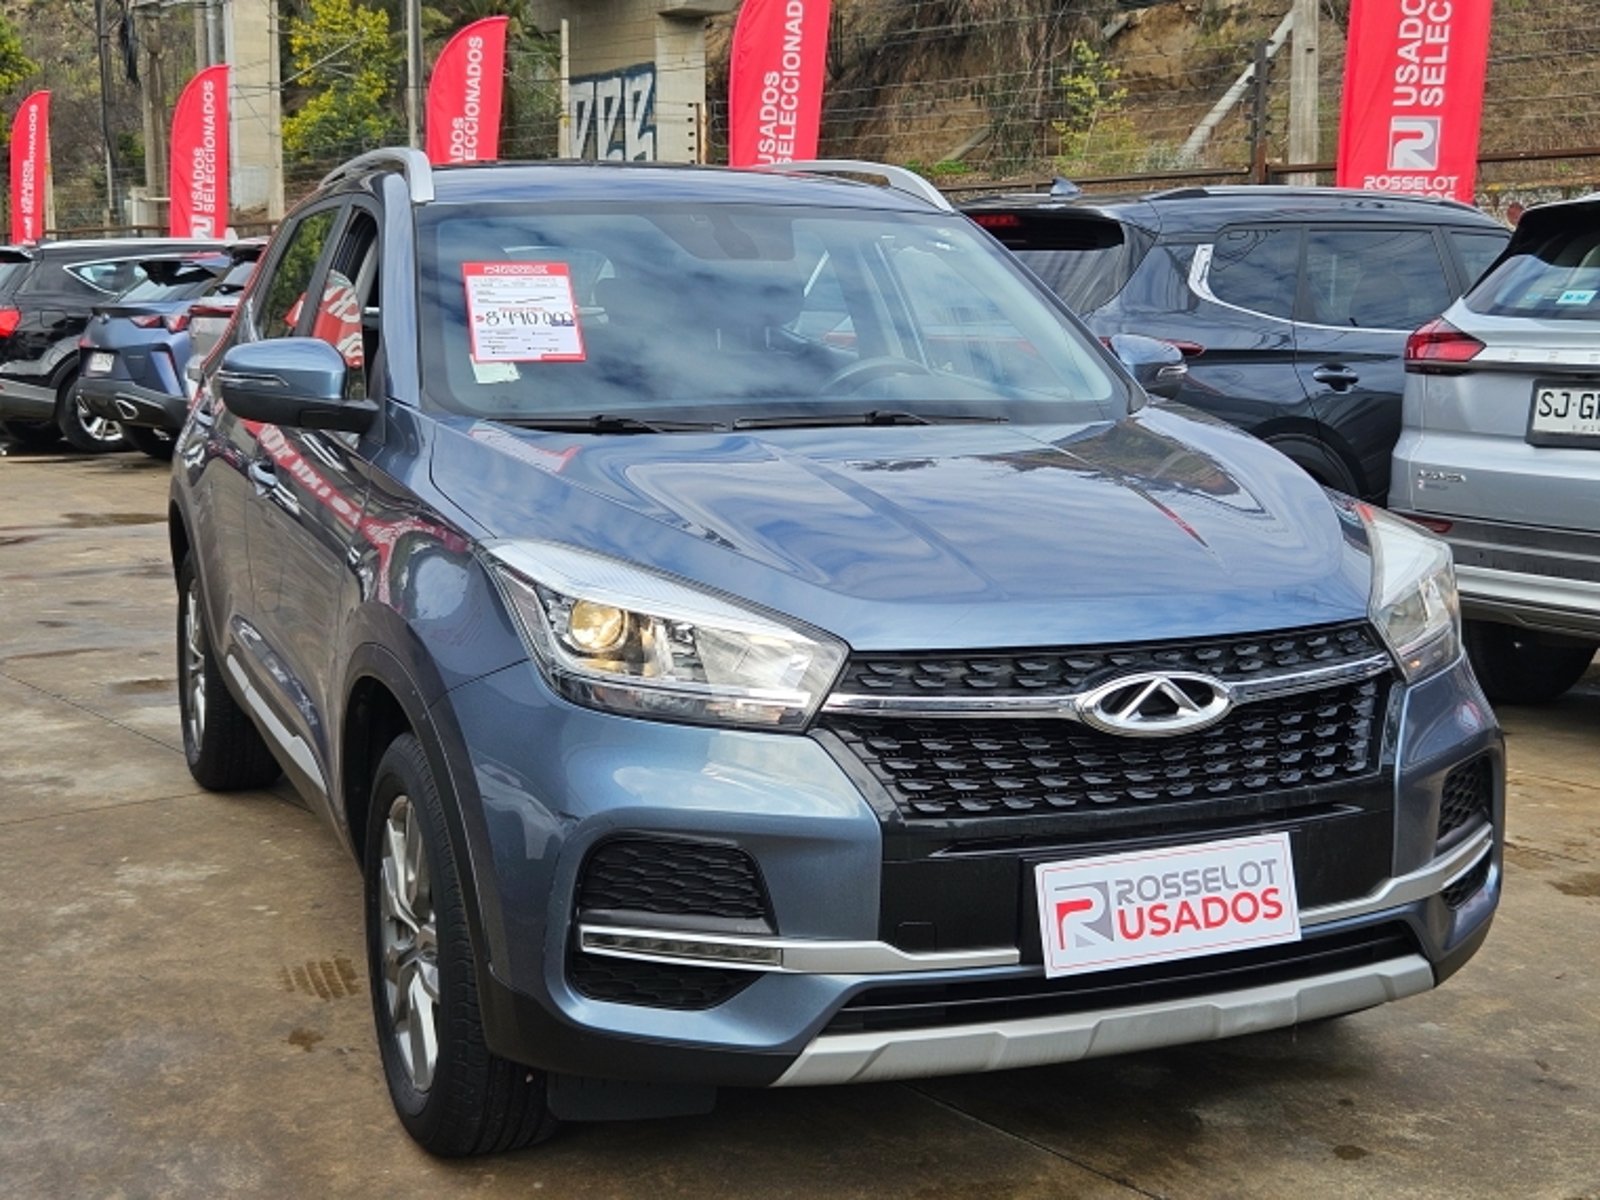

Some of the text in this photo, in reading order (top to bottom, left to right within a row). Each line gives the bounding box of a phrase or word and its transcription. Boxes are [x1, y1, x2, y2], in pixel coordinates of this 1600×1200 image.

[202, 81, 216, 213] SELECCIONADOS
[192, 147, 205, 212] USADOS
[1364, 175, 1459, 190] ROSSELOT
[1115, 859, 1278, 905] ROSSELOT
[1117, 887, 1284, 941] USADOS
